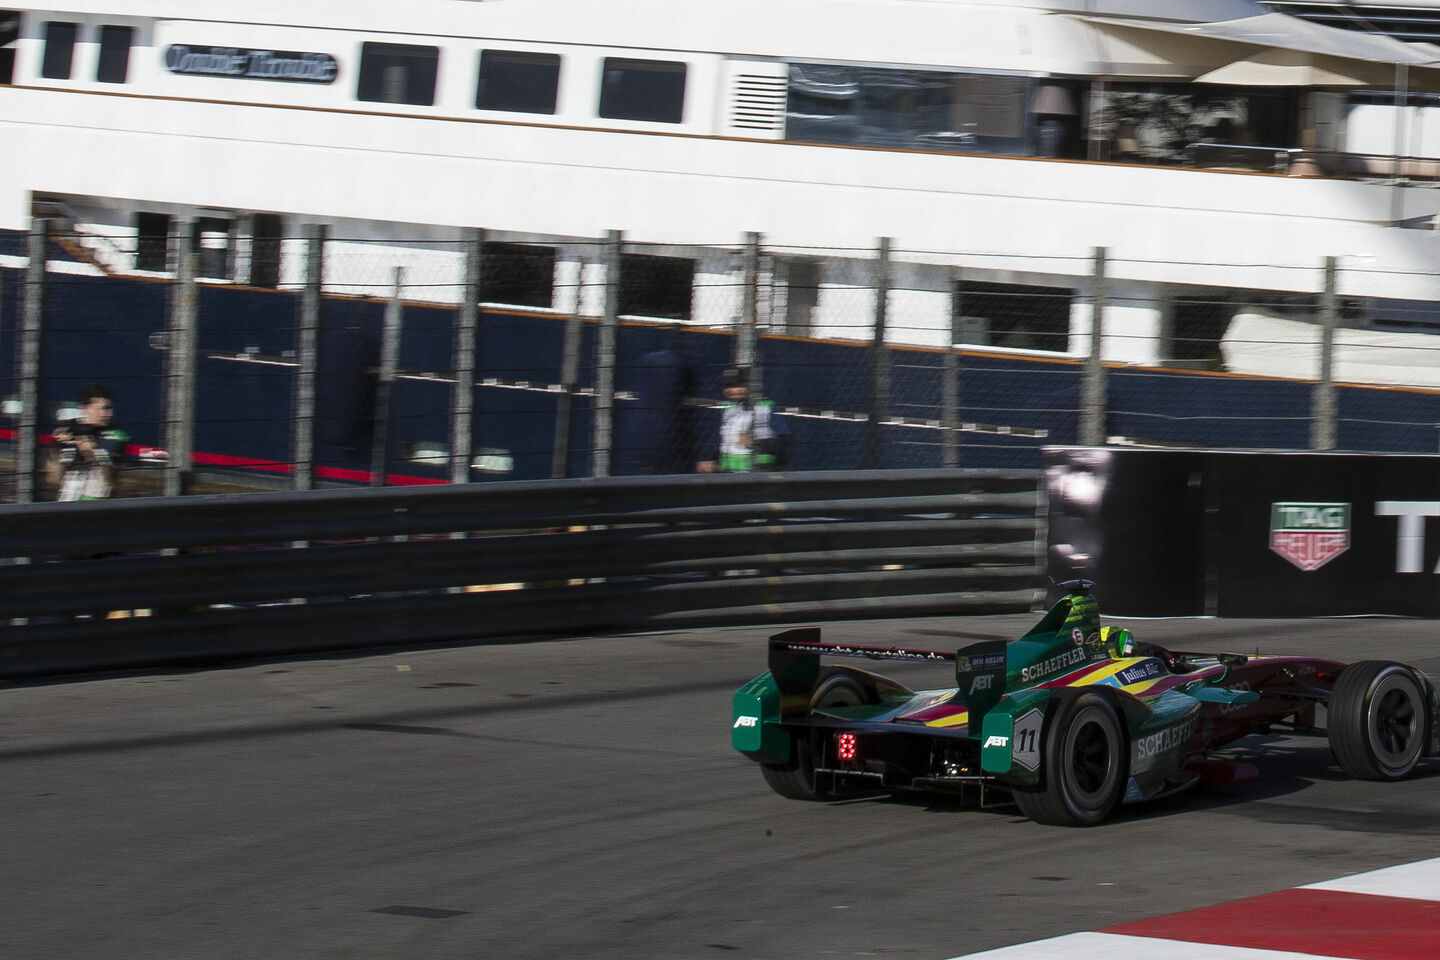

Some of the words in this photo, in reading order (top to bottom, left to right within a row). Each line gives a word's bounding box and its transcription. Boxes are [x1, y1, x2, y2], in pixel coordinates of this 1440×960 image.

[1278, 507, 1344, 528] TAG
[1021, 647, 1086, 682] SCHAEFFLER
[1122, 667, 1147, 683] Julius
[969, 674, 995, 696] ABT
[733, 716, 759, 728] ABT
[983, 736, 1009, 748] ABT
[1019, 728, 1036, 753] 11
